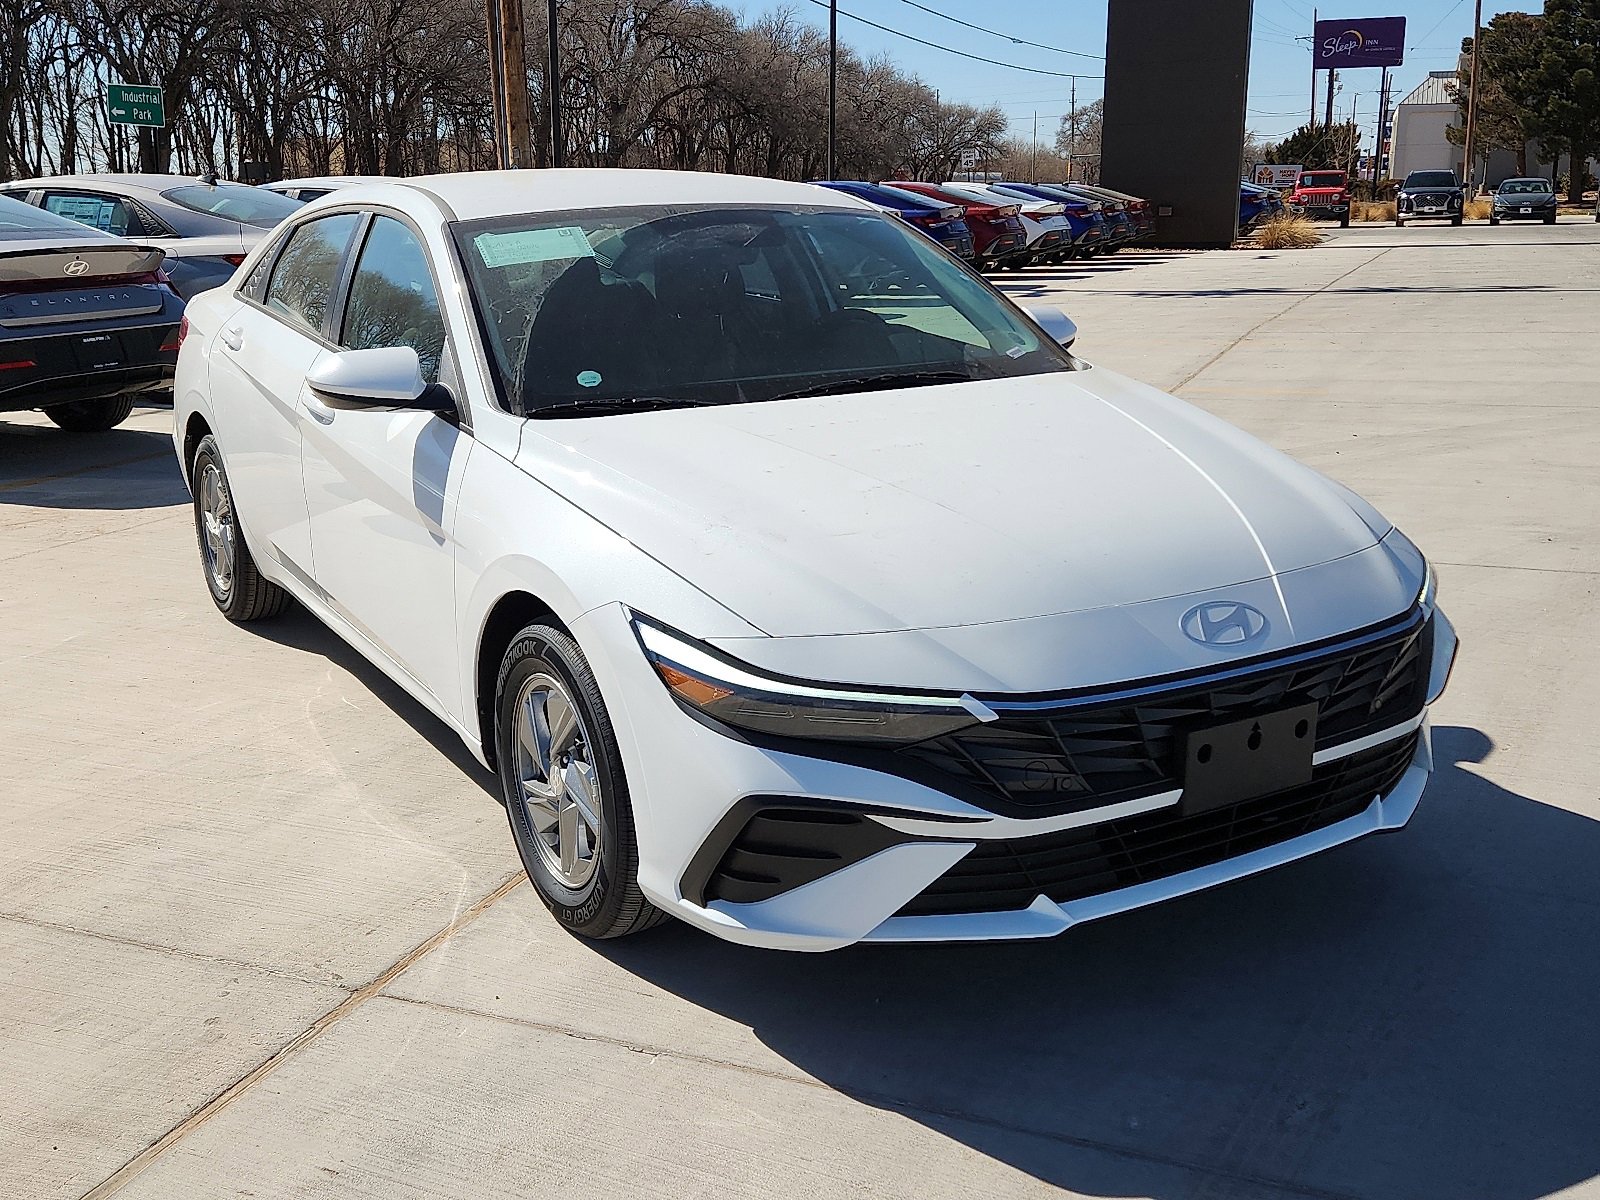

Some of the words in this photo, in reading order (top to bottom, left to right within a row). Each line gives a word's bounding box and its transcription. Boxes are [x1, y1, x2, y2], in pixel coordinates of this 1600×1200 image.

[1322, 37, 1358, 58] Sleep
[122, 91, 160, 104] Industrial
[133, 108, 152, 120] Park
[31, 293, 130, 306] ELANTRA
[574, 879, 604, 925] KINERGY
[562, 909, 572, 921] GT
